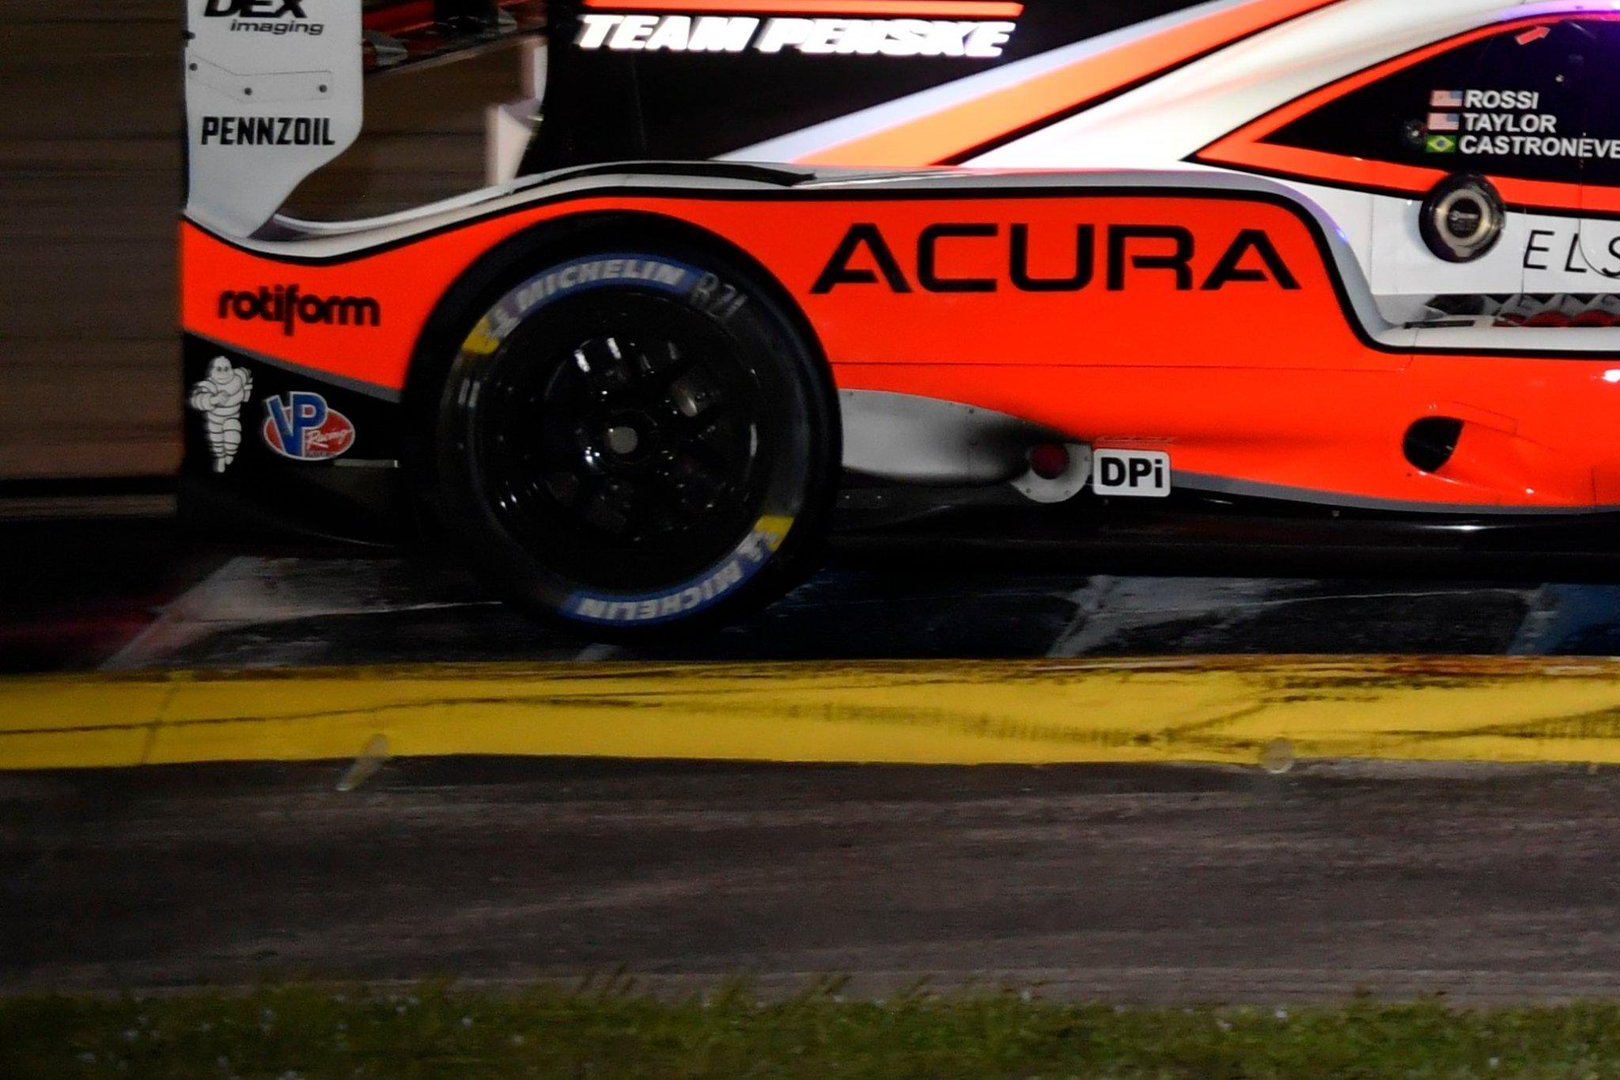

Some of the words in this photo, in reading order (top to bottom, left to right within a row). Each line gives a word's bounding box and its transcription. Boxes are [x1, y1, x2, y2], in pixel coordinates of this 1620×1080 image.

[230, 18, 324, 36] imaging
[575, 13, 759, 52] TEAM
[755, 17, 1016, 58] PENSKE
[1465, 89, 1539, 109] ROSSI
[201, 116, 336, 146] PENNZOIL
[1462, 112, 1557, 133] TAYLOR
[808, 222, 1302, 294] ACURA
[514, 258, 688, 313] MICHELIN
[218, 284, 381, 336] rotiform
[265, 391, 328, 459] VP
[1101, 457, 1163, 488] DPi
[576, 560, 743, 621] MICHELIN
